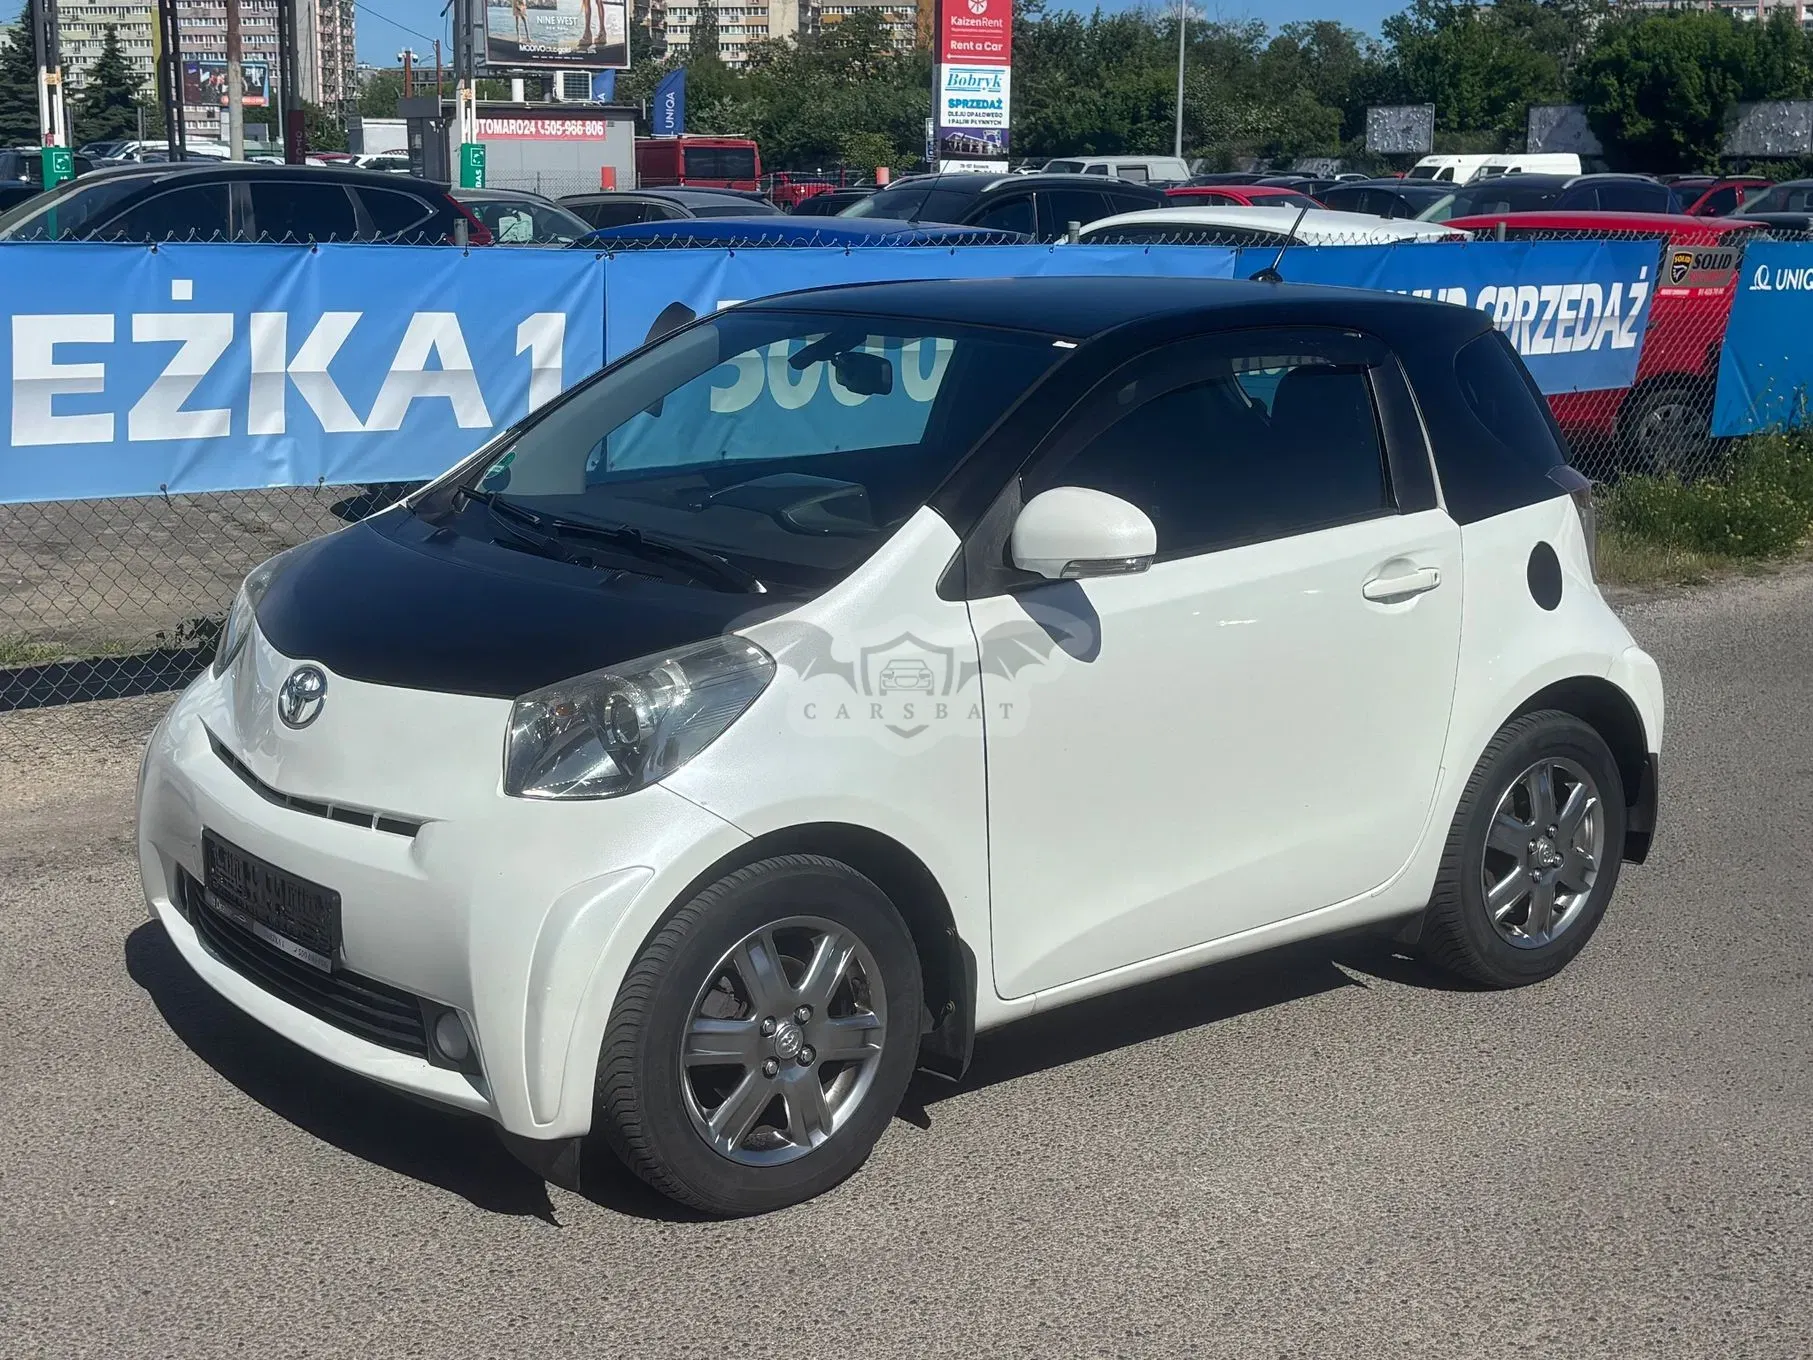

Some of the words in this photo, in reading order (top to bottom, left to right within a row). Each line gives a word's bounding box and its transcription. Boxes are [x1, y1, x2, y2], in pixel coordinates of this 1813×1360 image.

[950, 15, 1003, 28] KaizenRent
[950, 40, 974, 50] Rent
[975, 43, 983, 51] a
[984, 41, 1003, 51] Car
[947, 73, 1002, 89] Bobryk
[665, 91, 675, 129] UNIQA
[948, 97, 1003, 110] SPRZEDAŻ
[1692, 253, 1732, 270] SOLID
[11, 279, 493, 446] EŻKA
